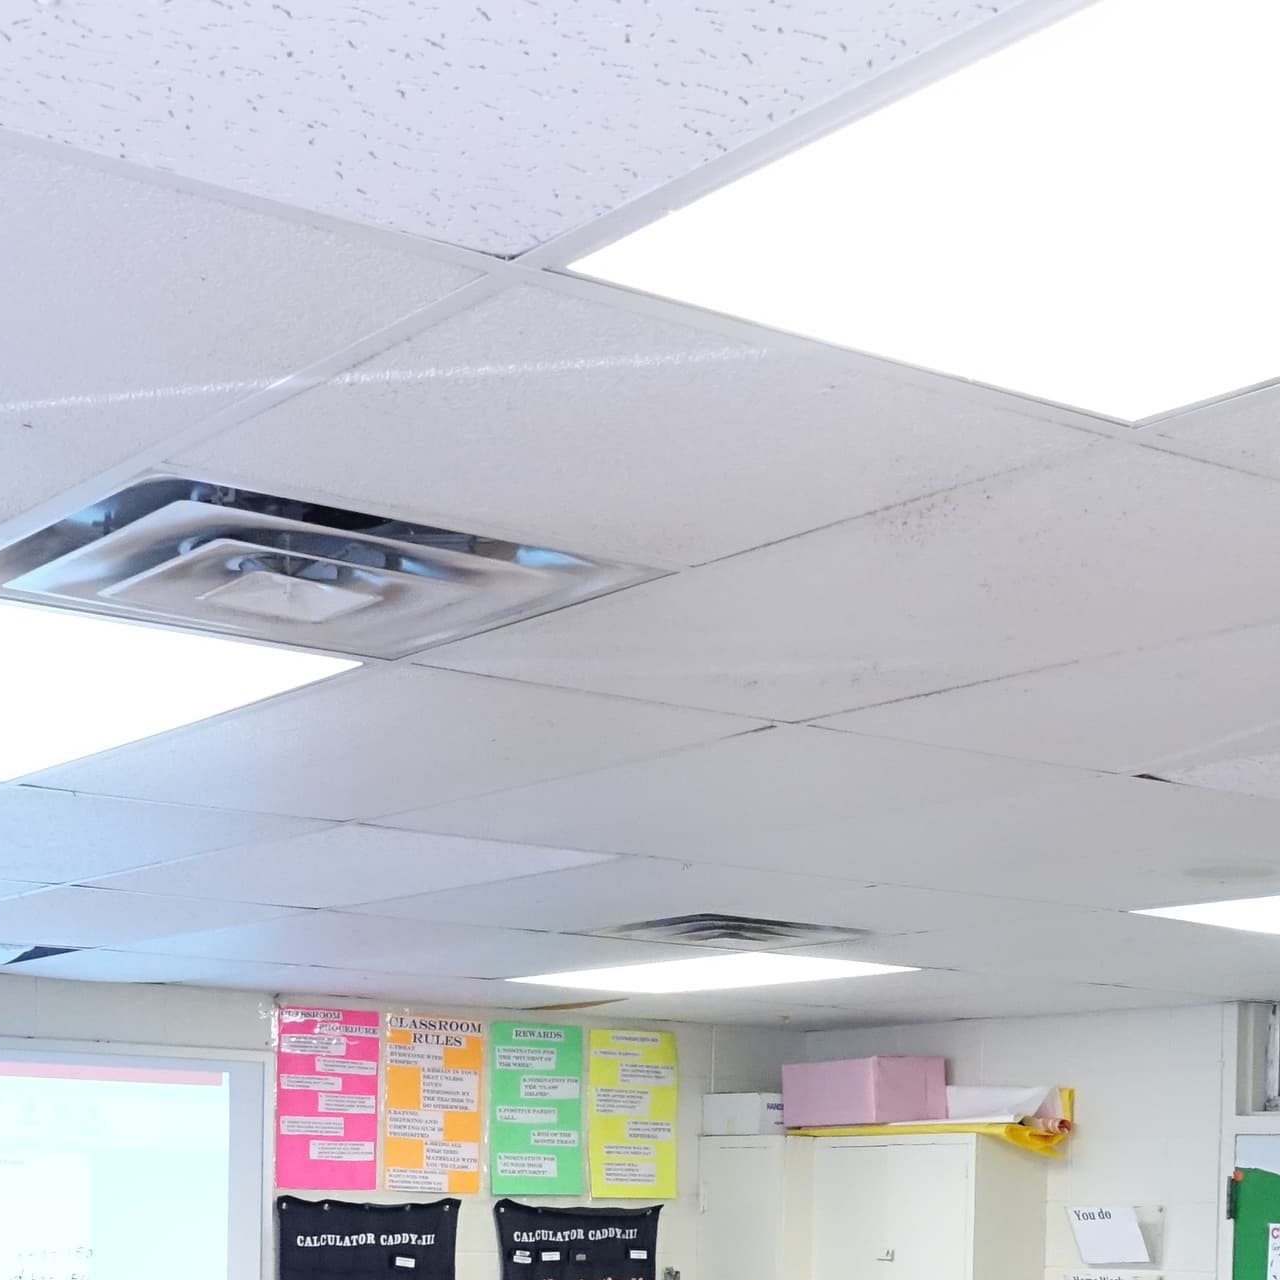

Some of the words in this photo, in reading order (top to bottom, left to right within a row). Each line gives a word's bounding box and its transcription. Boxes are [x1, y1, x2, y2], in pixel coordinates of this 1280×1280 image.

[389, 1016, 482, 1033] CLASSROOM
[412, 1033, 462, 1047] RULES
[515, 1030, 563, 1039] REWARDS
[1074, 1209, 1095, 1221] You
[1098, 1208, 1111, 1220] do
[296, 1232, 375, 1247] CALCULATOR
[513, 1228, 584, 1242] CALCULATOR
